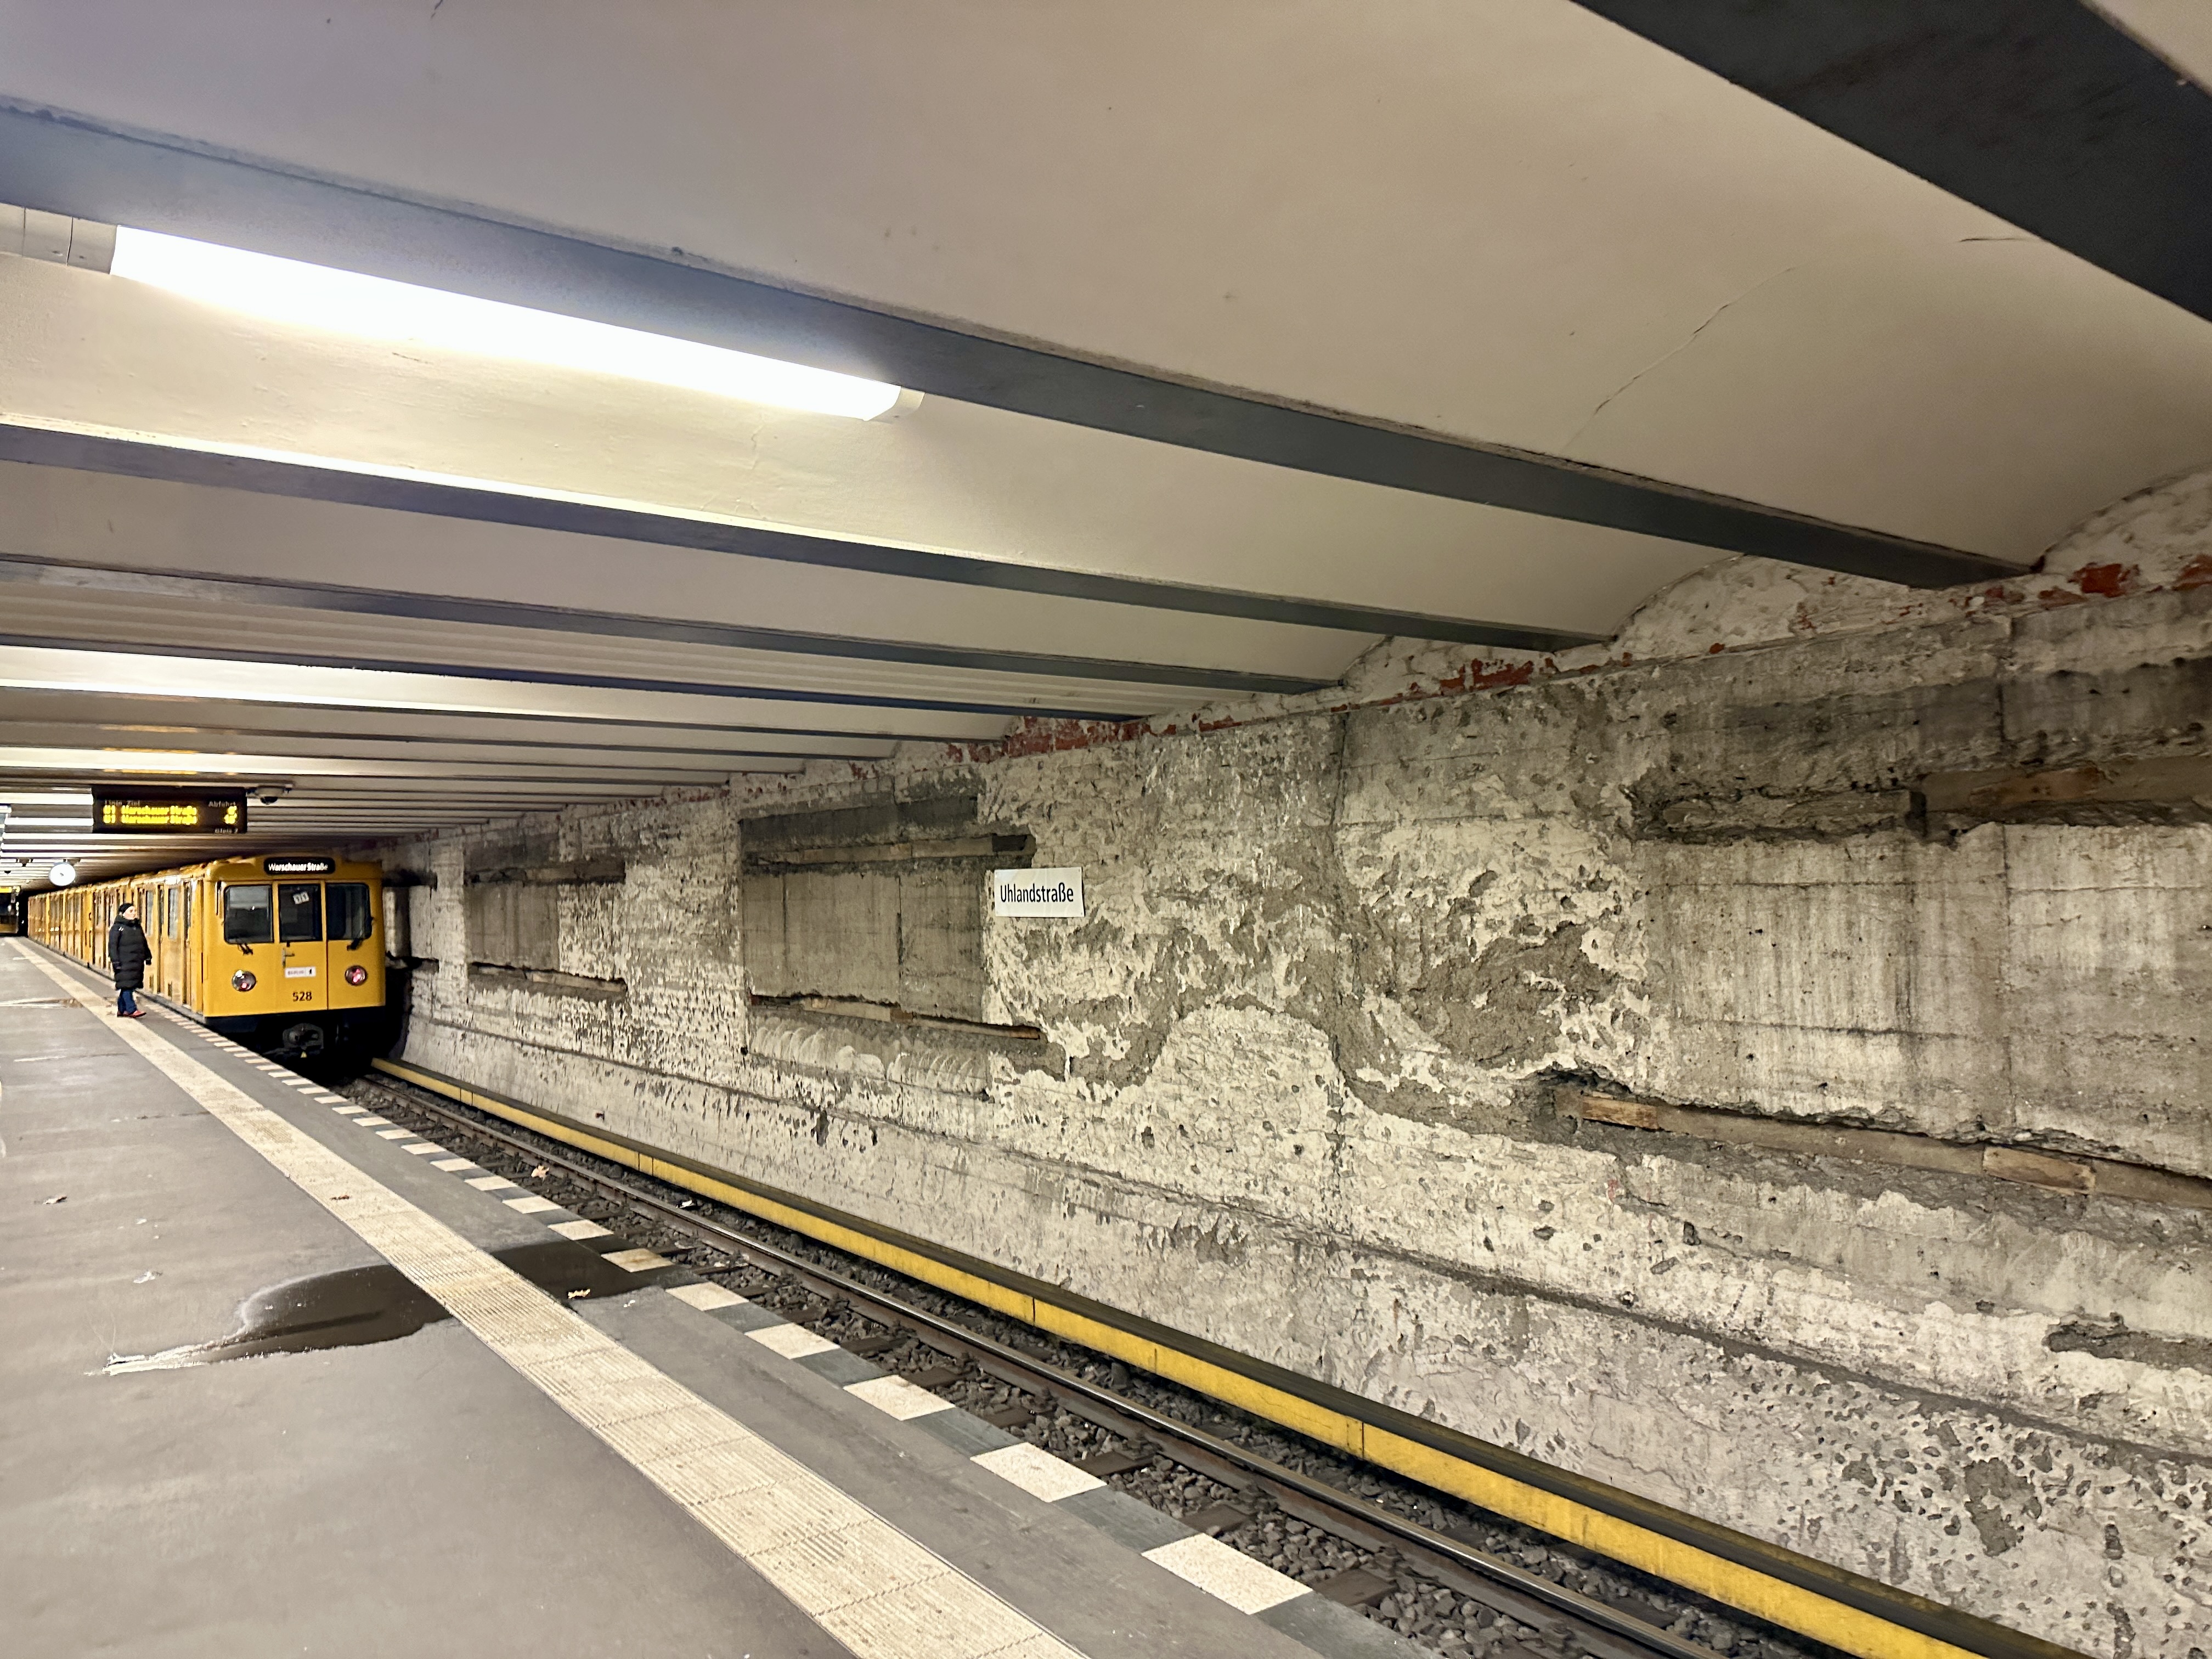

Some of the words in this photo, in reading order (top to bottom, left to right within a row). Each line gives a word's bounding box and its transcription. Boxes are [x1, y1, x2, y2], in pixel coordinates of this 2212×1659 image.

[268, 862, 307, 871] Warschauer
[1000, 882, 1074, 903] Uhlandstraße
[292, 991, 313, 1002] 528
